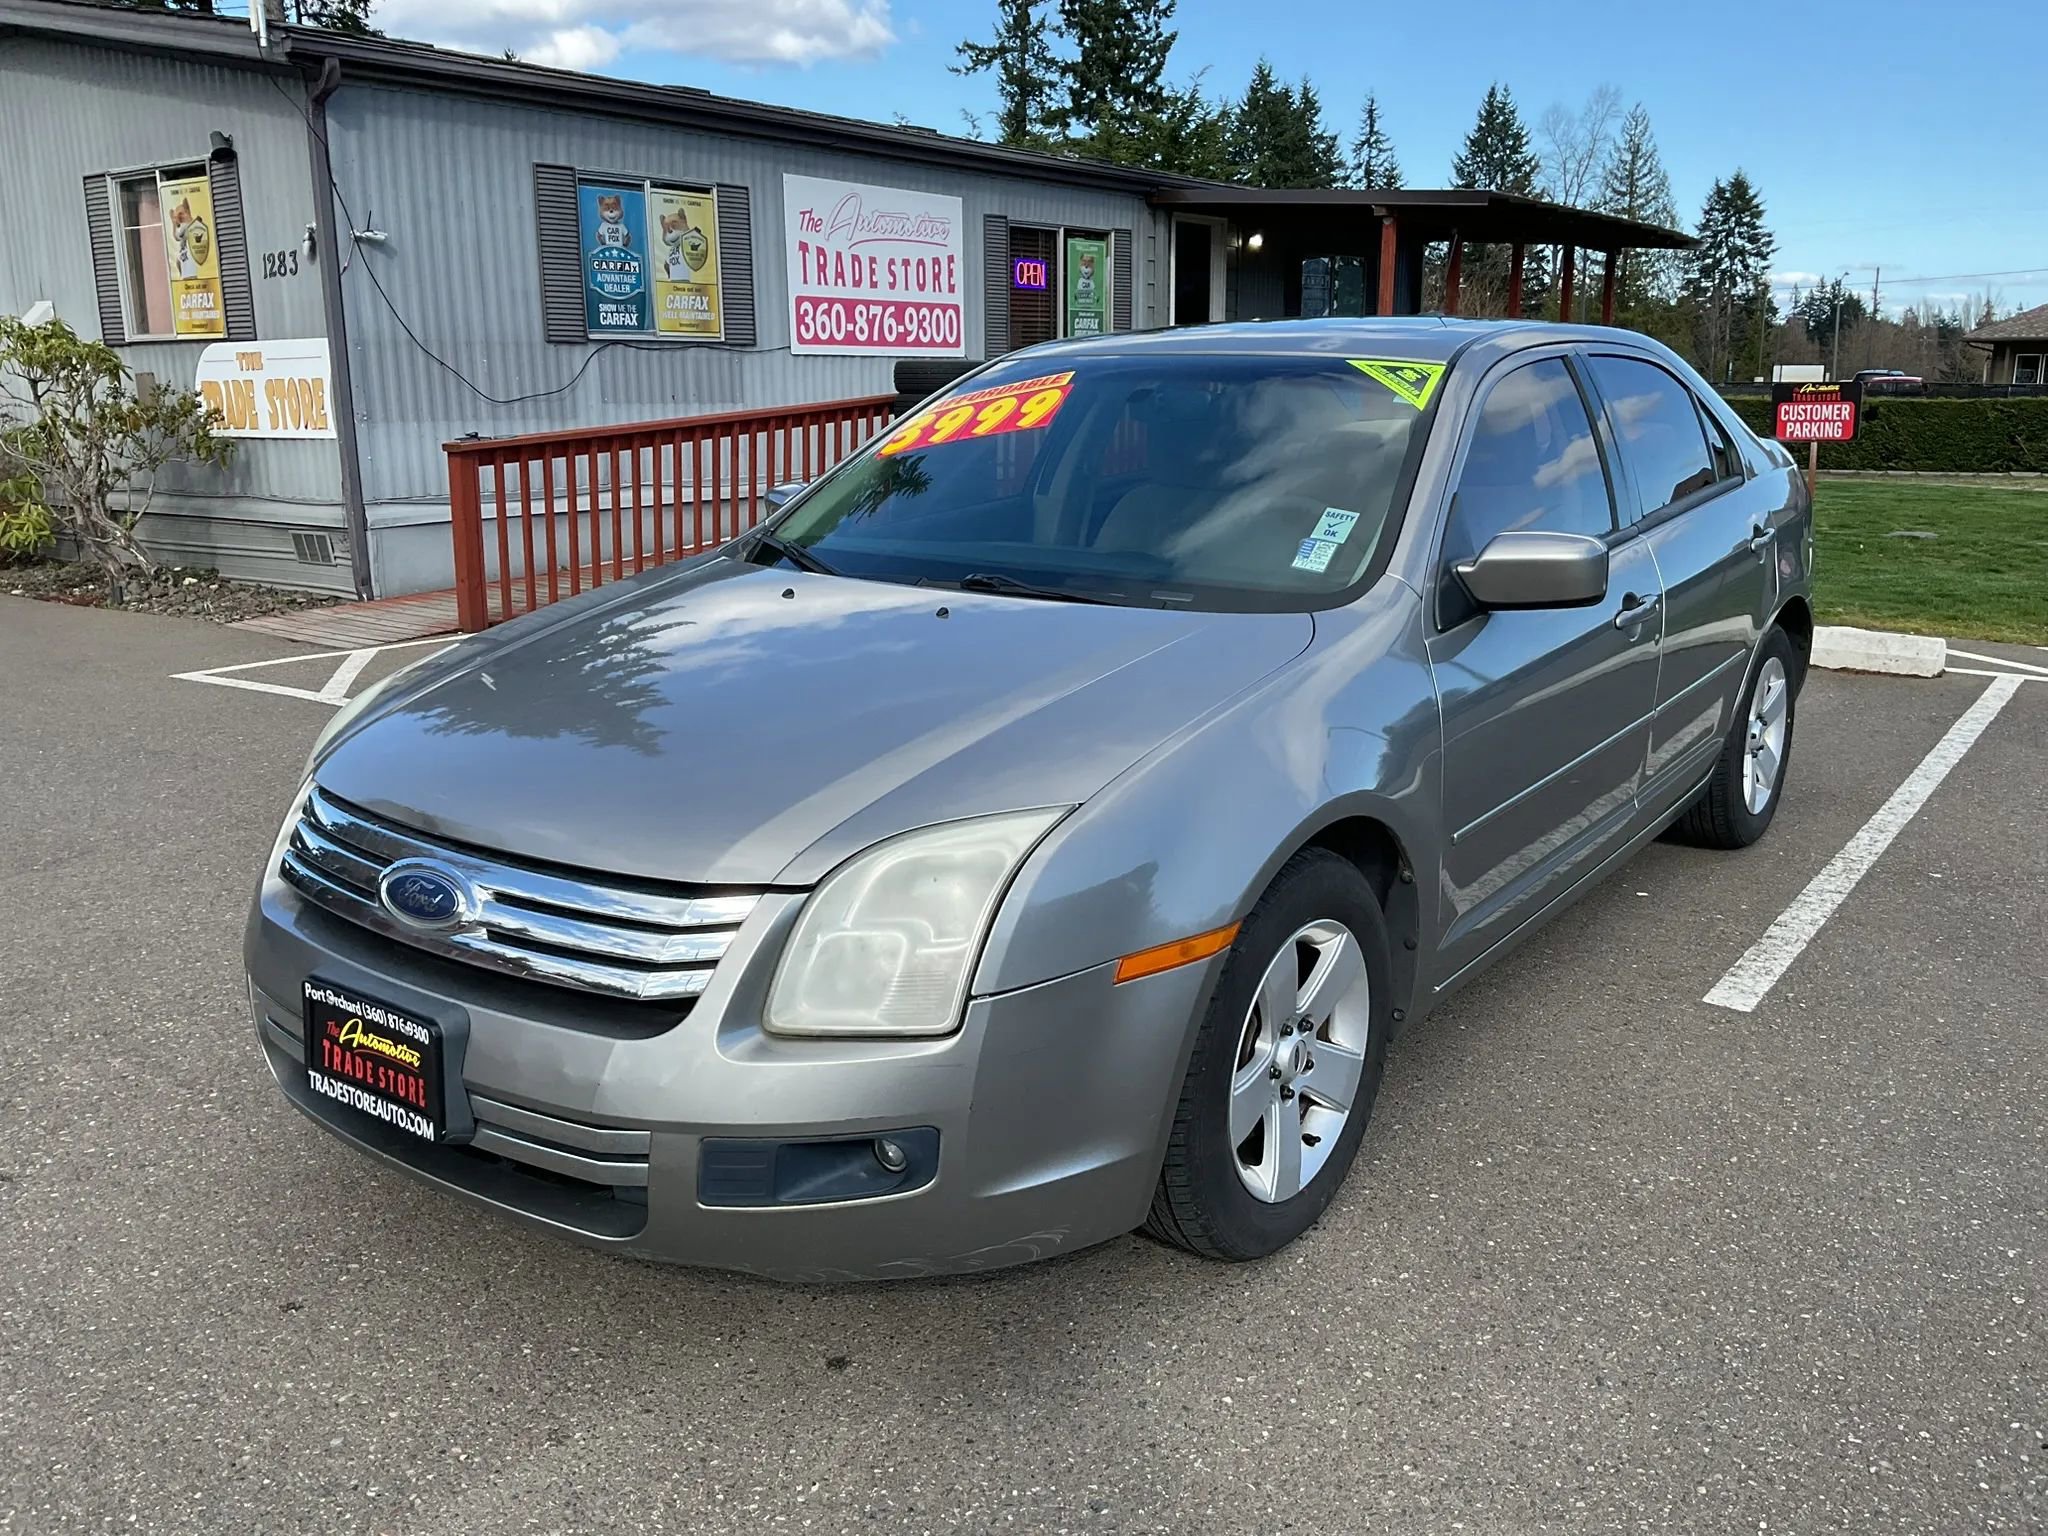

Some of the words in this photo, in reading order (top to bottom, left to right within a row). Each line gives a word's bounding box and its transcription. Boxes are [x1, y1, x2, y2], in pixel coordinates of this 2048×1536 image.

[799, 208, 823, 233] The
[825, 192, 951, 241] Automotive
[607, 227, 620, 235] CAR
[262, 249, 299, 280] 1283
[593, 261, 638, 272] CARFAX
[798, 240, 879, 289] TRADE
[887, 254, 956, 294] STORE
[597, 273, 637, 284] ADVANTAGE
[1017, 262, 1045, 286] OPEN
[604, 284, 630, 293] DEALER
[180, 292, 214, 309] CARFAX
[598, 303, 617, 312] SHOW
[617, 304, 626, 312] ME
[626, 304, 637, 313] THE
[666, 294, 709, 310] CARFAX
[600, 312, 638, 326] CARFAX
[799, 301, 958, 344] 360-876-9300
[1074, 318, 1100, 329] CARFAX
[235, 351, 264, 371] THE
[937, 372, 1067, 408] AFFORDABLE
[264, 376, 328, 430] STORE
[1781, 404, 1850, 421] CUSTOMER
[1786, 421, 1843, 438] PARKING
[1325, 511, 1356, 522] SAFETY
[1323, 529, 1339, 537] OK
[304, 982, 326, 1003] Port
[326, 990, 362, 1016] Orchard
[362, 1002, 387, 1026] (360)
[388, 1014, 430, 1046] 876-9300
[326, 1020, 341, 1038] The
[338, 1018, 422, 1068] Automotive
[322, 1038, 374, 1084] TRADE
[378, 1066, 427, 1108] STORE
[307, 1070, 435, 1142] TRADESTOREAUTO.COM
